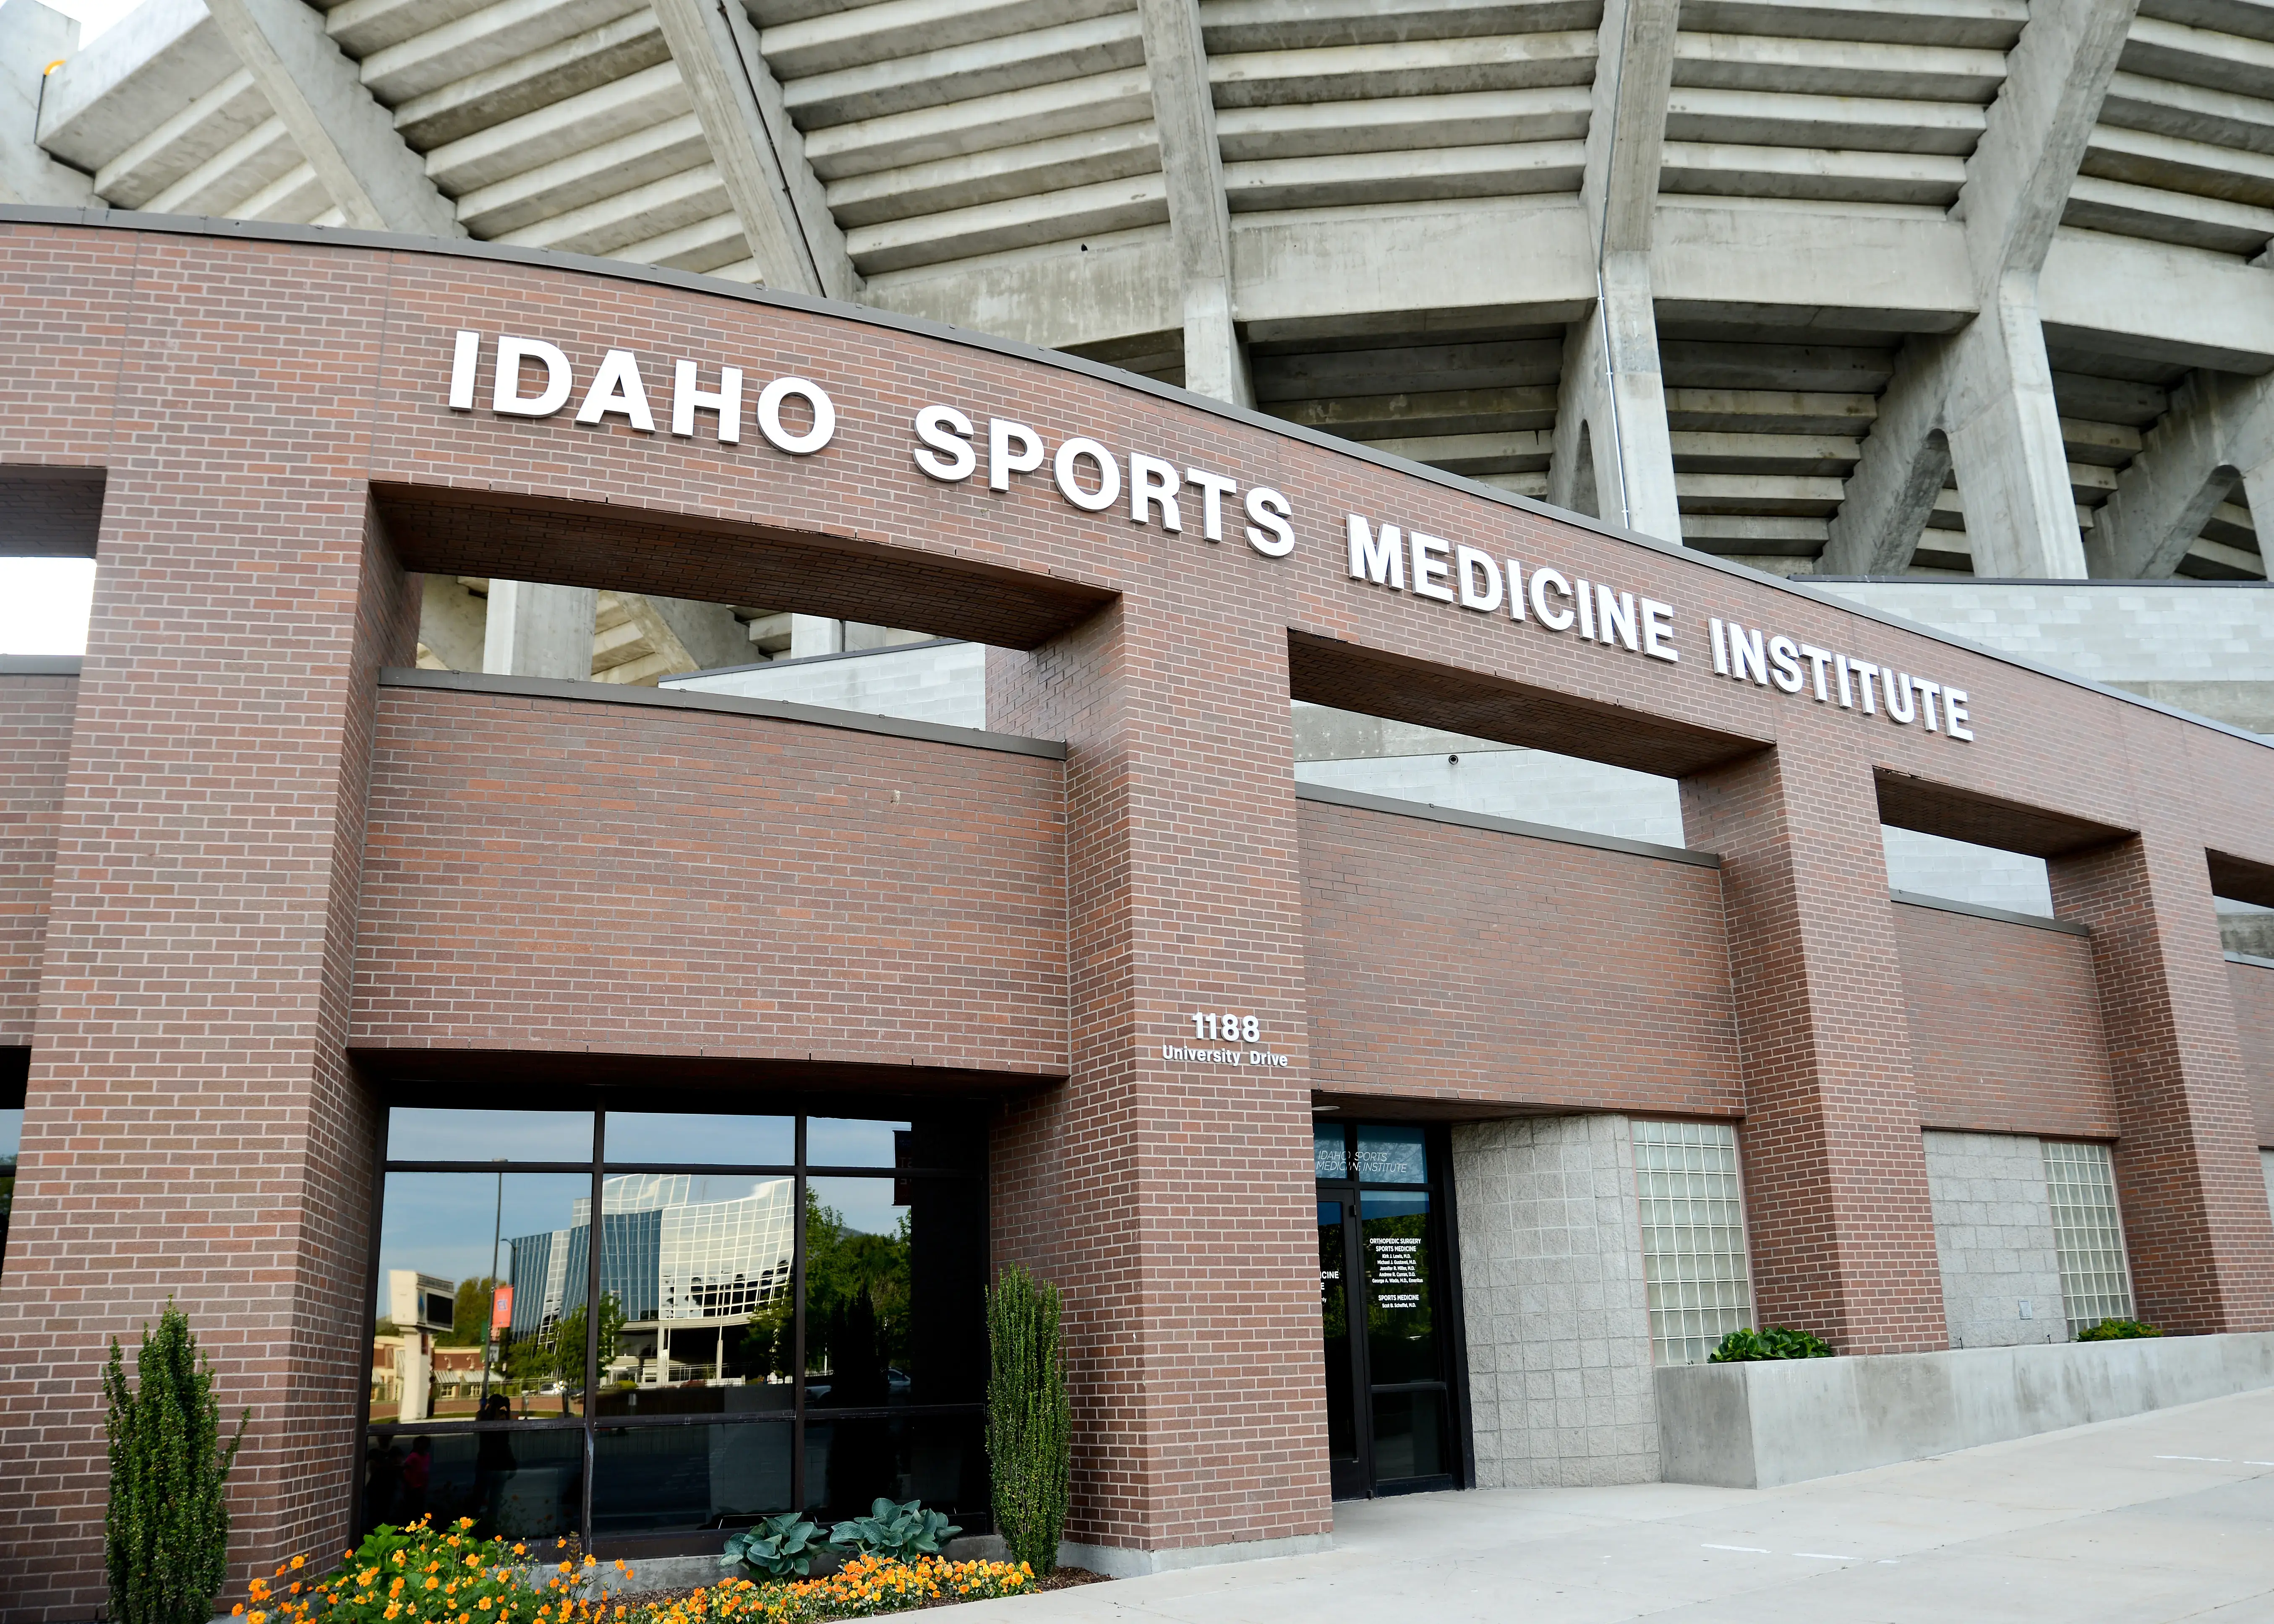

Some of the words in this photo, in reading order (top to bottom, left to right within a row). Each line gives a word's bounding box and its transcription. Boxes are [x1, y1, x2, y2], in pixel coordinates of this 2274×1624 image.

[449, 330, 836, 456] IDAHO
[913, 404, 1295, 558] SPORTS
[1345, 513, 1679, 664] MEDICINE
[1707, 617, 1974, 742] INSTITUTE
[1191, 1011, 1260, 1043] 1188
[1162, 1045, 1240, 1067] University
[1249, 1050, 1288, 1067] Drive
[1318, 1150, 1350, 1160] IDAHO
[1354, 1152, 1387, 1162] SPORTS
[1363, 1162, 1407, 1173] INSTITUTE
